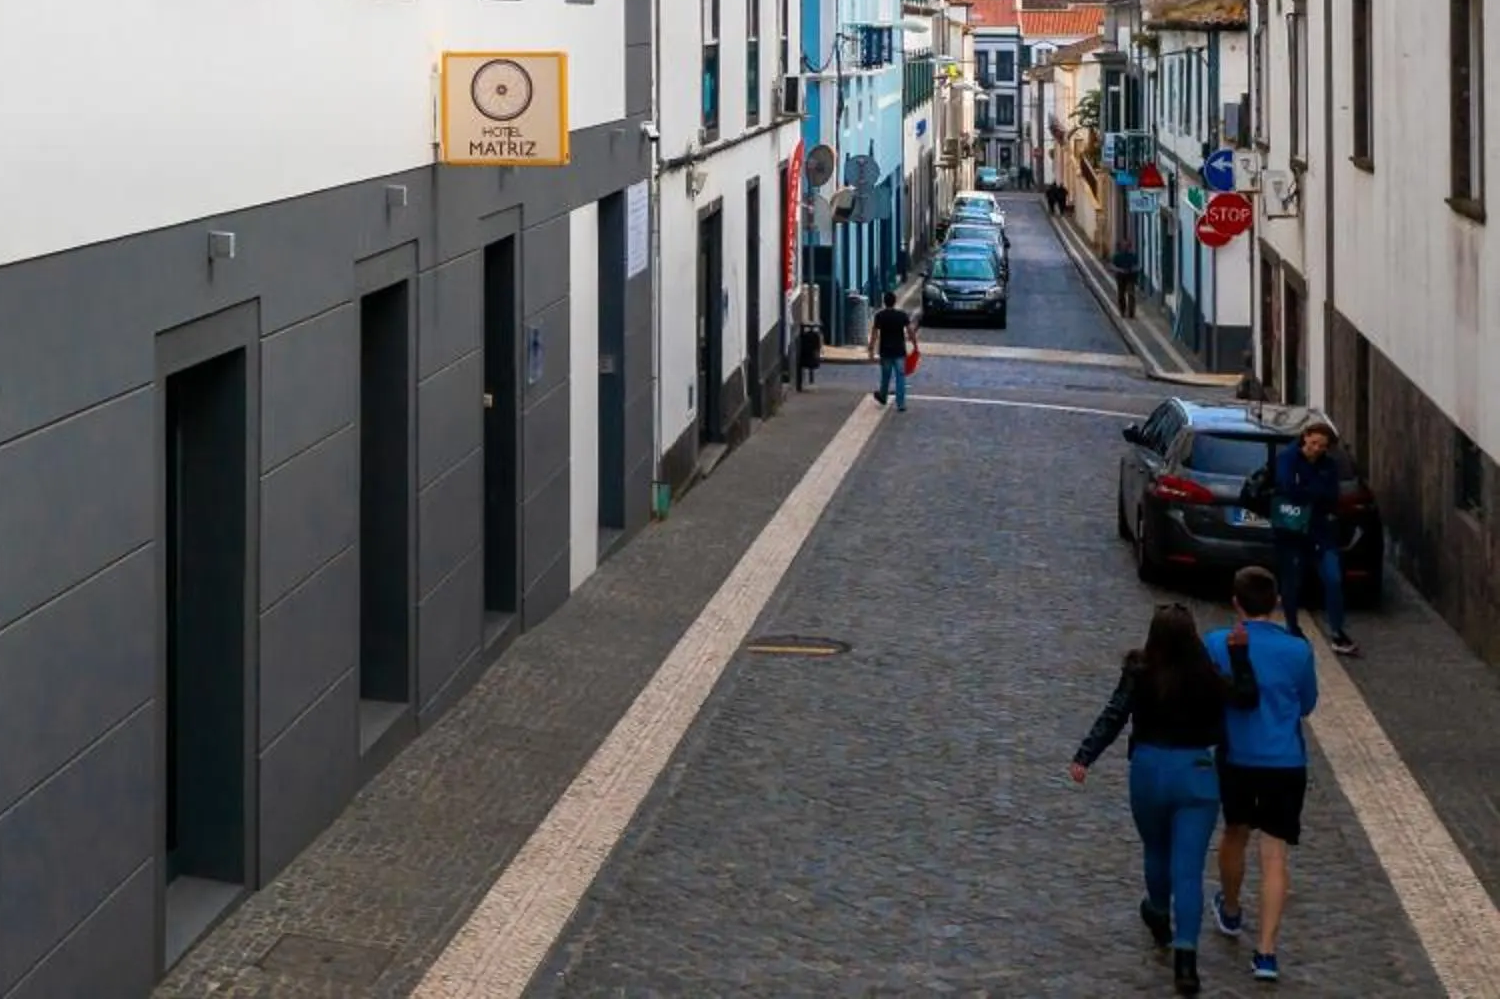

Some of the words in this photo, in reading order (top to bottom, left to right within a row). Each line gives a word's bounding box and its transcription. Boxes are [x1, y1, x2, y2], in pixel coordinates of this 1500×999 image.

[482, 126, 523, 138] HOTEL
[469, 140, 536, 156] MATRIZ
[1210, 206, 1250, 221] STOP
